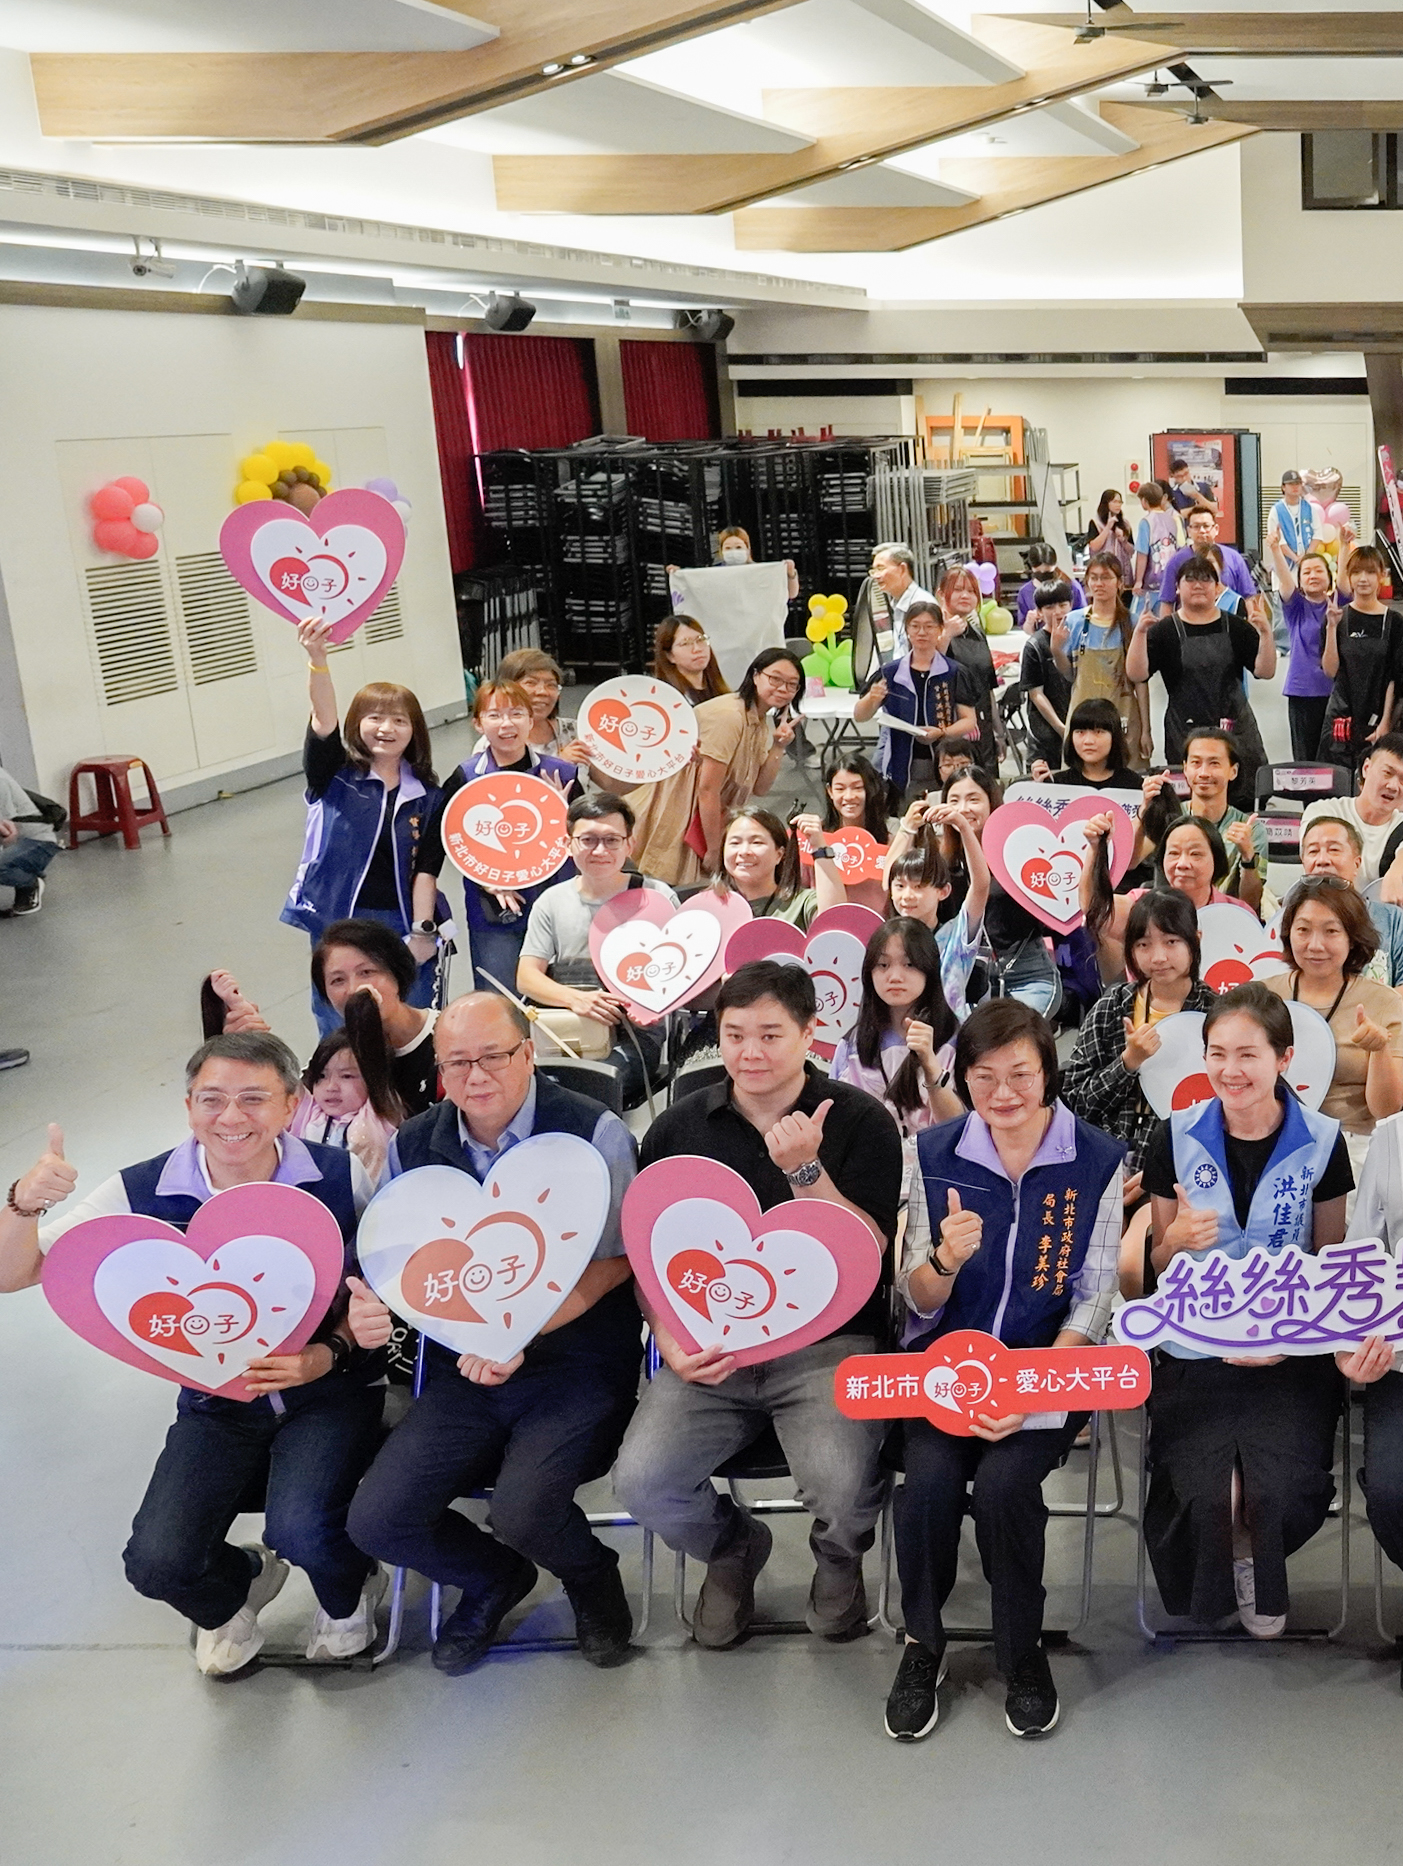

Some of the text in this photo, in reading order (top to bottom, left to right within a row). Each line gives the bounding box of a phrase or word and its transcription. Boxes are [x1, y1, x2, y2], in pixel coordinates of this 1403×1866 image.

[1031, 1193, 1056, 1292] 局長 李美珍
[1052, 1187, 1078, 1297] 新北市政府社會局
[1267, 1174, 1298, 1249] 洪佳君
[845, 1374, 920, 1400] 新北市
[1016, 1364, 1140, 1395] 愛心大平台
